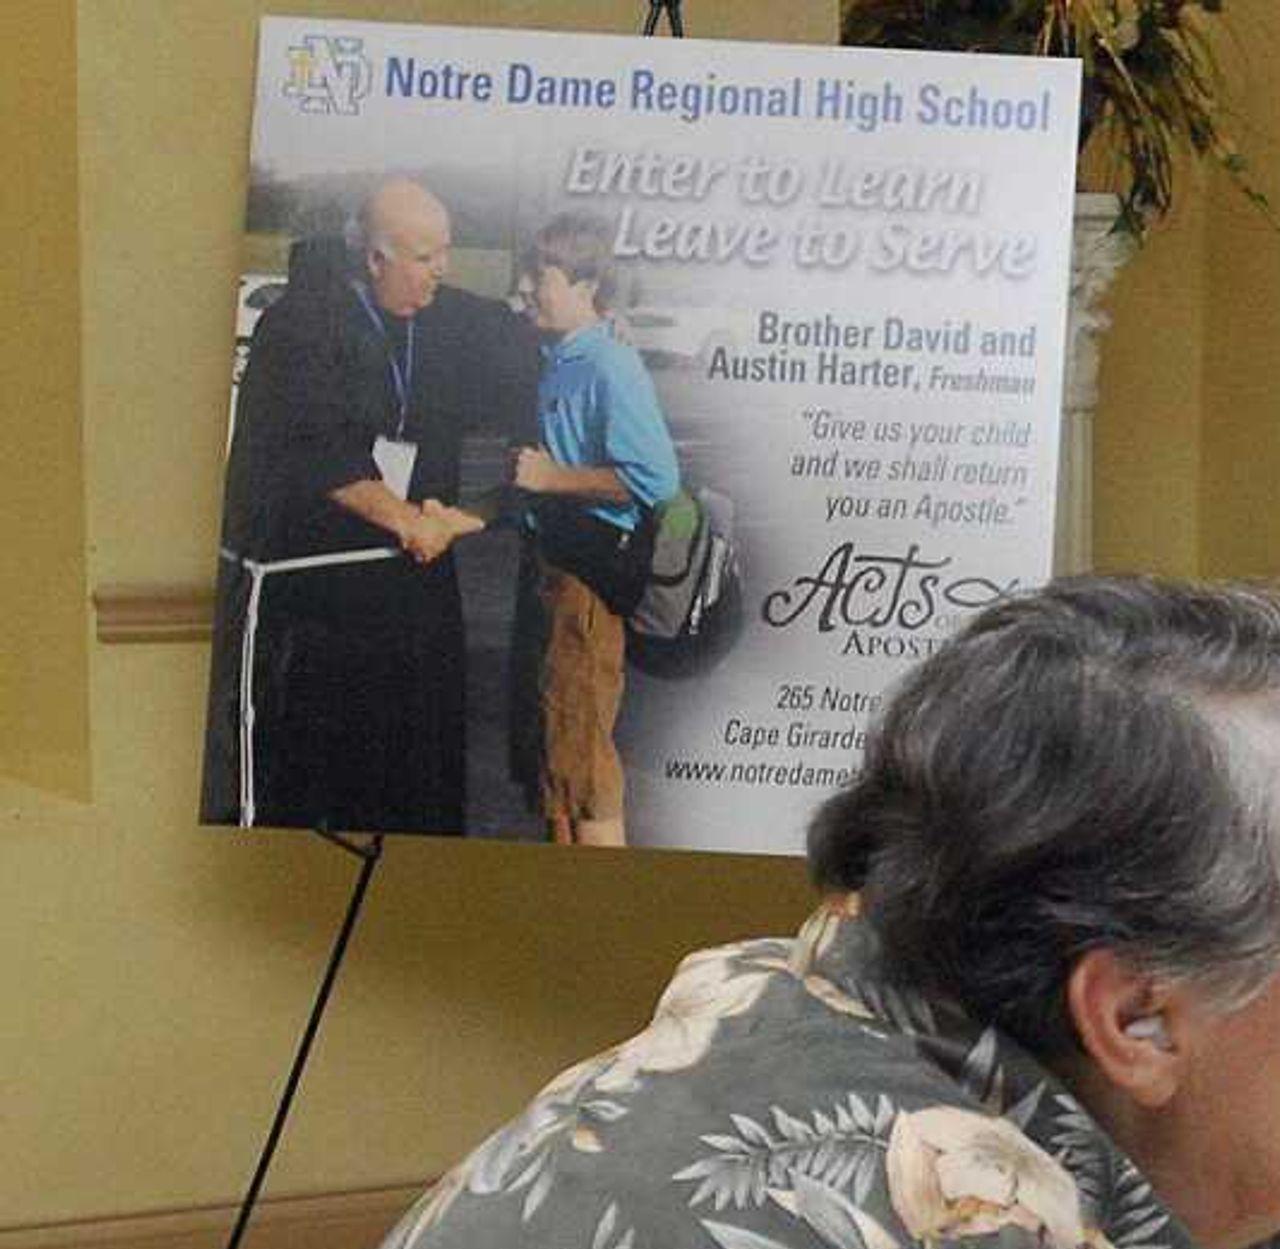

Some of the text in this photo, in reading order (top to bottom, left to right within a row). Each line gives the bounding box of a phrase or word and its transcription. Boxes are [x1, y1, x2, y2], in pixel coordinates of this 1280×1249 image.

[386, 56, 1052, 133] Notre Dame Regional High School
[567, 143, 984, 214] Enter to Learn
[611, 206, 1037, 278] Leave to Serve
[758, 311, 1037, 357] Brother David and
[707, 346, 1036, 397] Austin Harter, Freshman
[873, 421, 902, 443] us
[909, 421, 964, 449] your
[971, 421, 1032, 448] child
[791, 449, 1028, 487] and we shall return
[825, 496, 869, 523] you
[877, 497, 907, 520] an
[841, 629, 942, 658] APOST
[777, 684, 883, 713] 265 Notre
[724, 718, 868, 751] Cape Girarde
[664, 759, 857, 790] www.notredame
